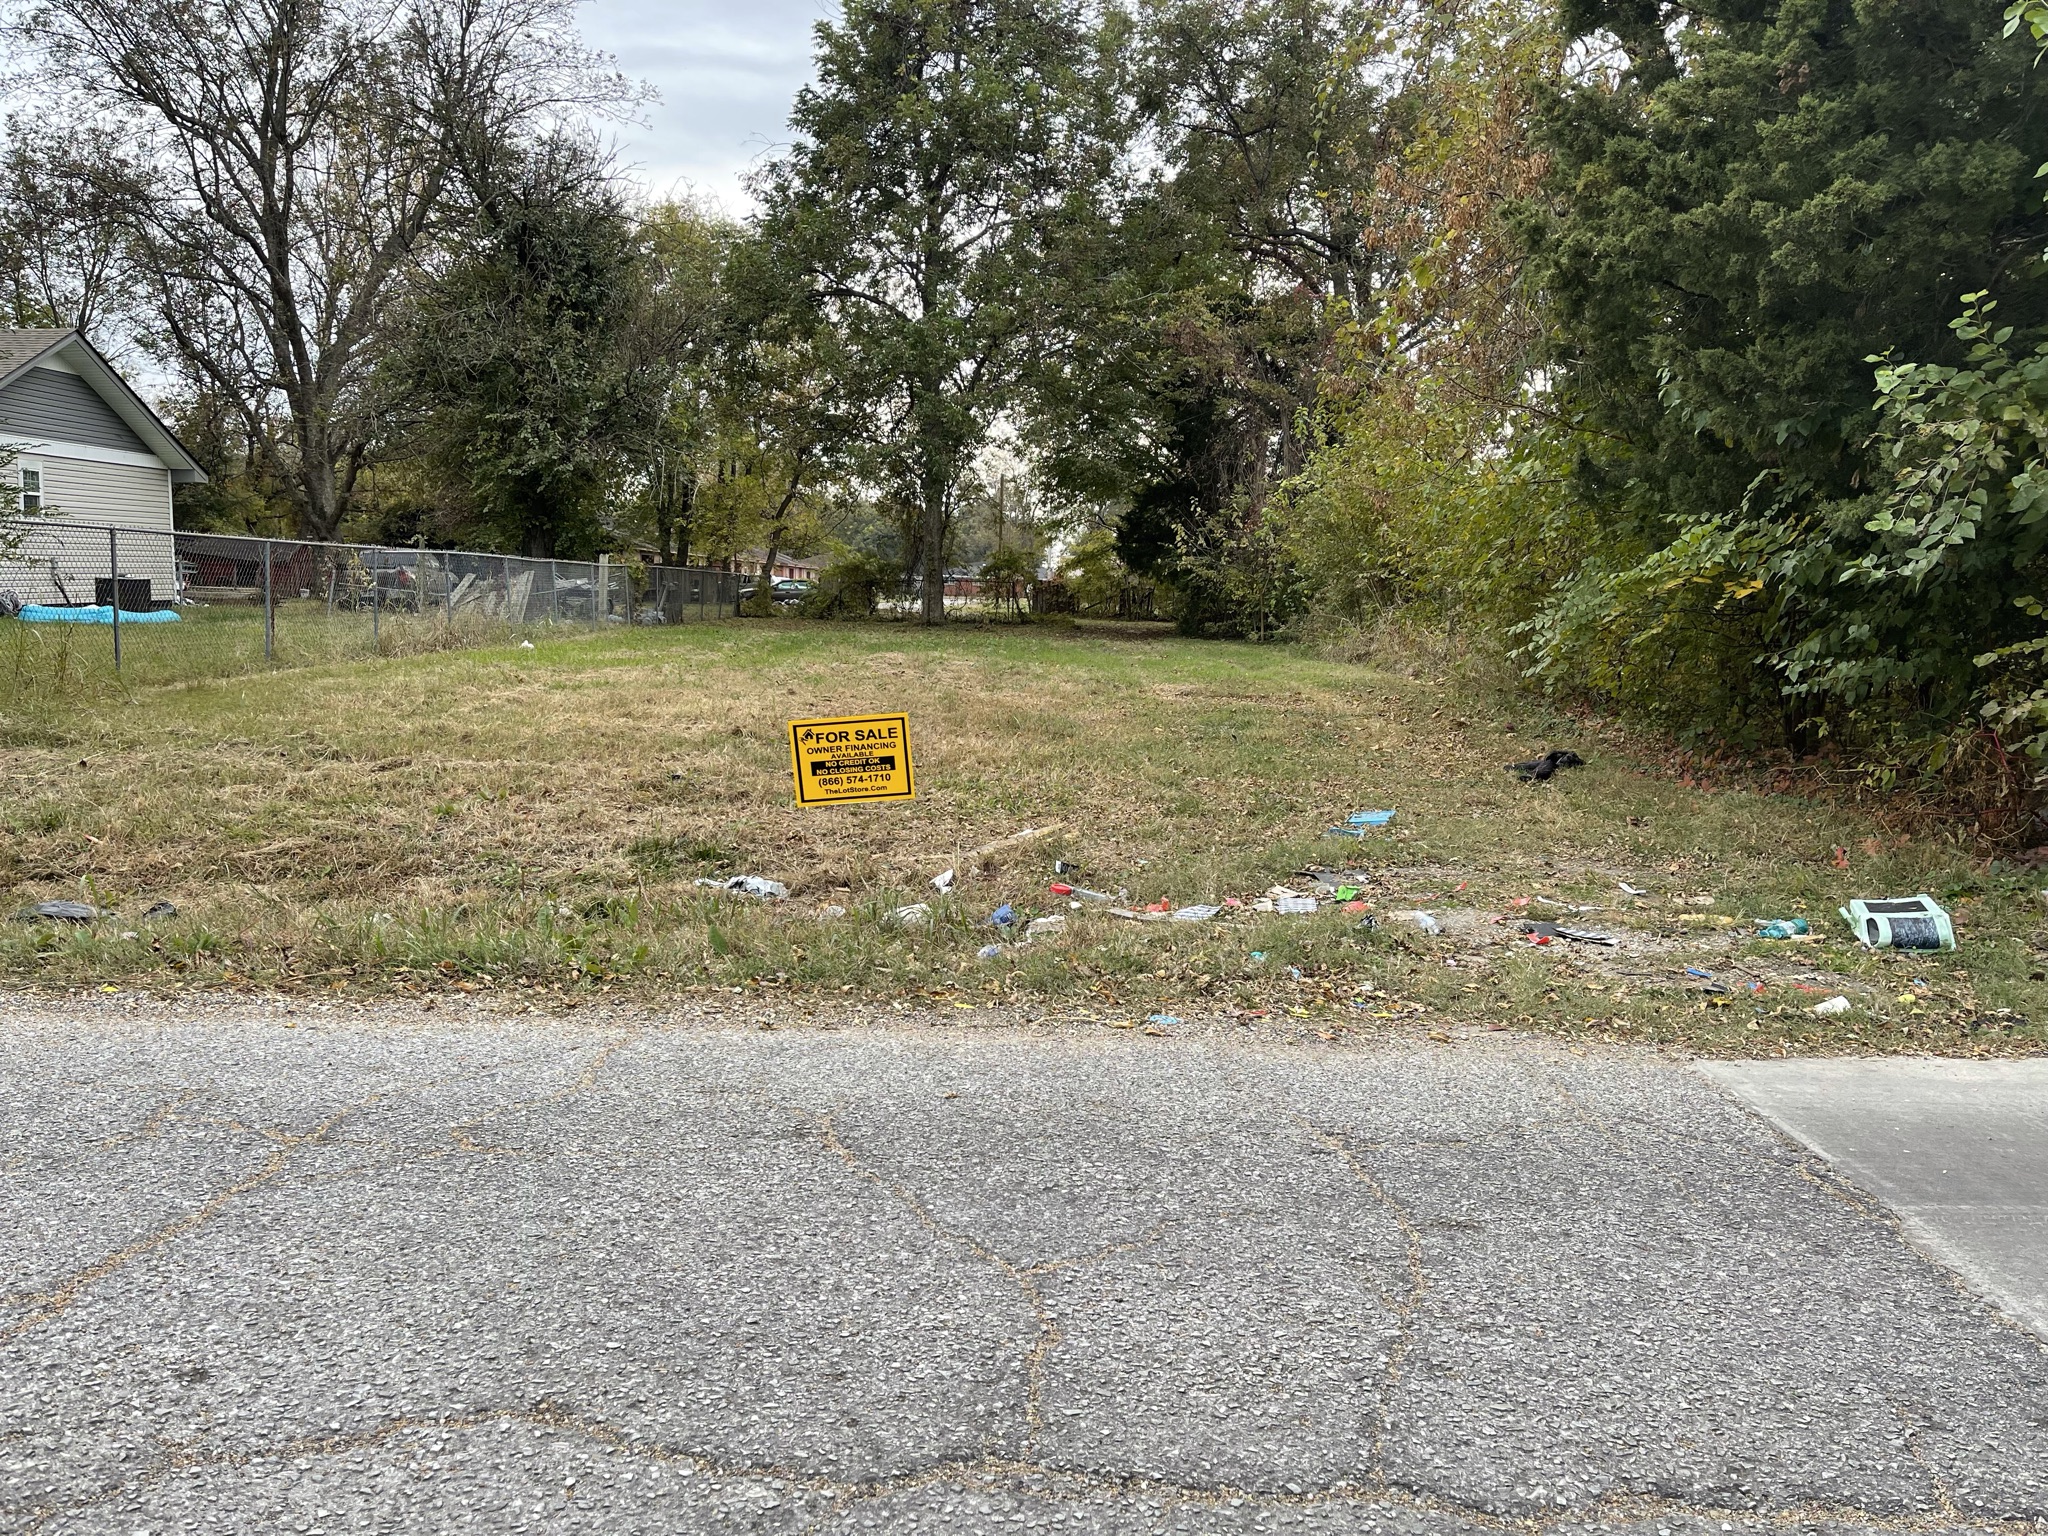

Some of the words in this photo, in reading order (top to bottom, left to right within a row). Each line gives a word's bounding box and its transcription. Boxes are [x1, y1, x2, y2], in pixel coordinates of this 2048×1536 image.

[815, 731, 851, 744] FOR
[854, 727, 898, 741] SALE
[806, 745, 843, 755] OWNER
[845, 741, 897, 752] FINANCING
[831, 751, 874, 759] AVAILABLE
[829, 766, 864, 775] CLOSING
[818, 776, 844, 788] (866)
[846, 773, 891, 784] 574-1710
